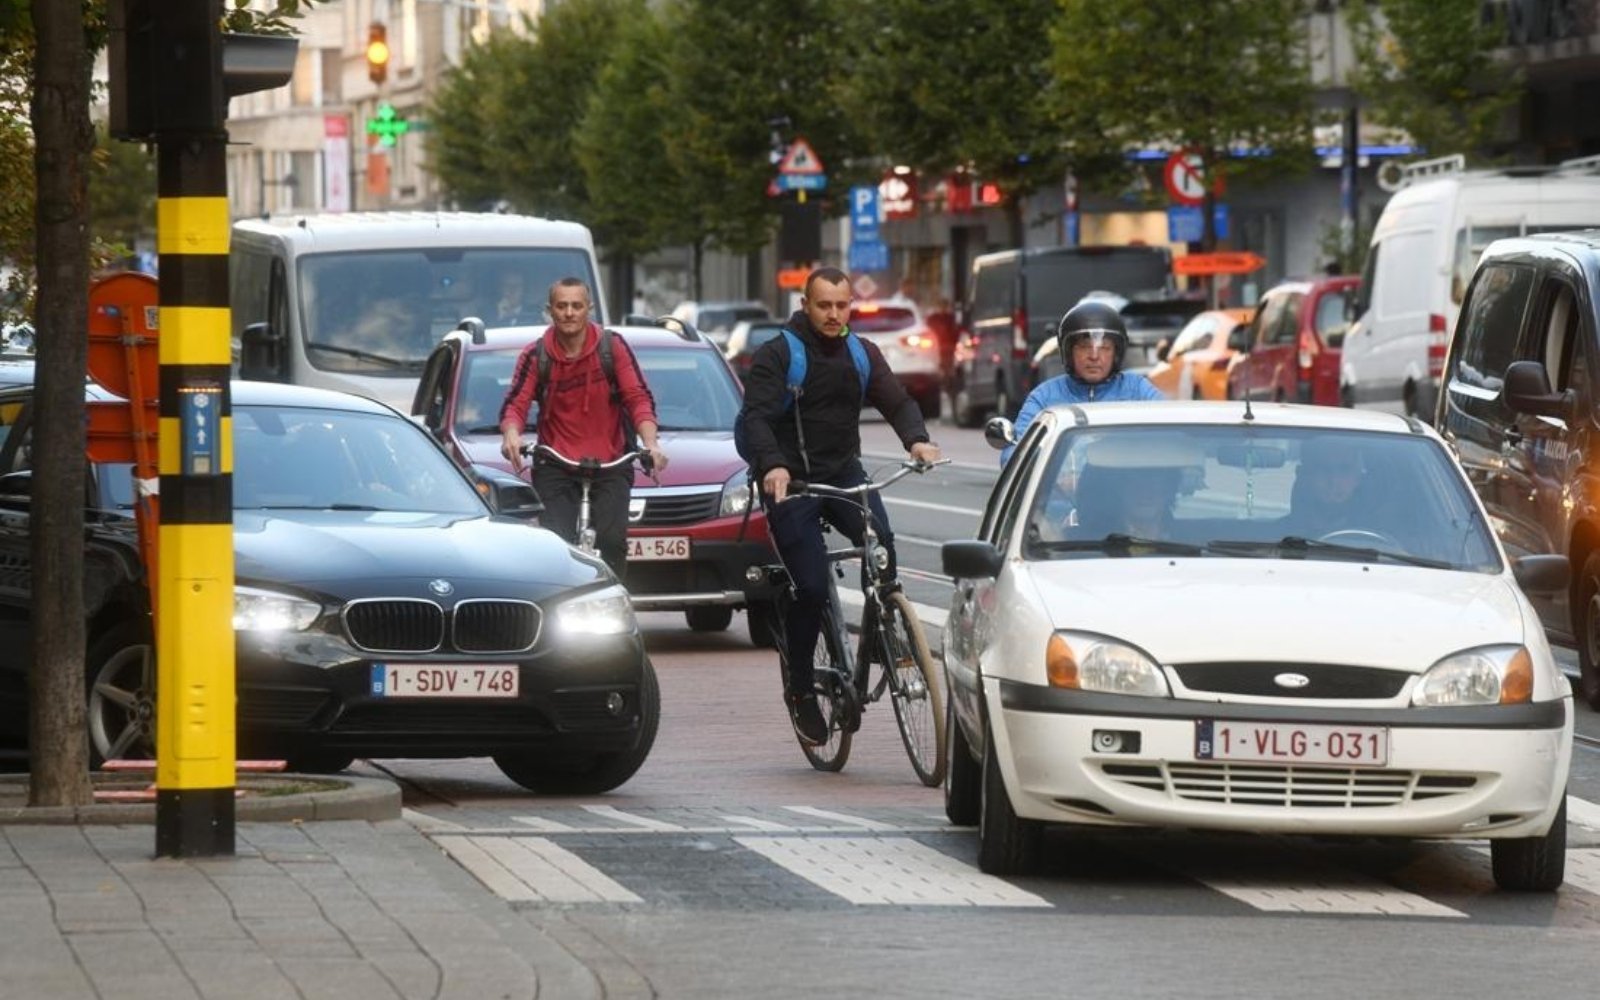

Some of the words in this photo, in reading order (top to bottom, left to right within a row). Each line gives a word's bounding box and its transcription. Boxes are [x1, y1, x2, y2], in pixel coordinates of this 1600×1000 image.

[856, 190, 873, 213] P
[390, 669, 514, 692] 1-SDV-748
[1200, 741, 1210, 753] B
[1219, 728, 1379, 760] 1-VLG-031
